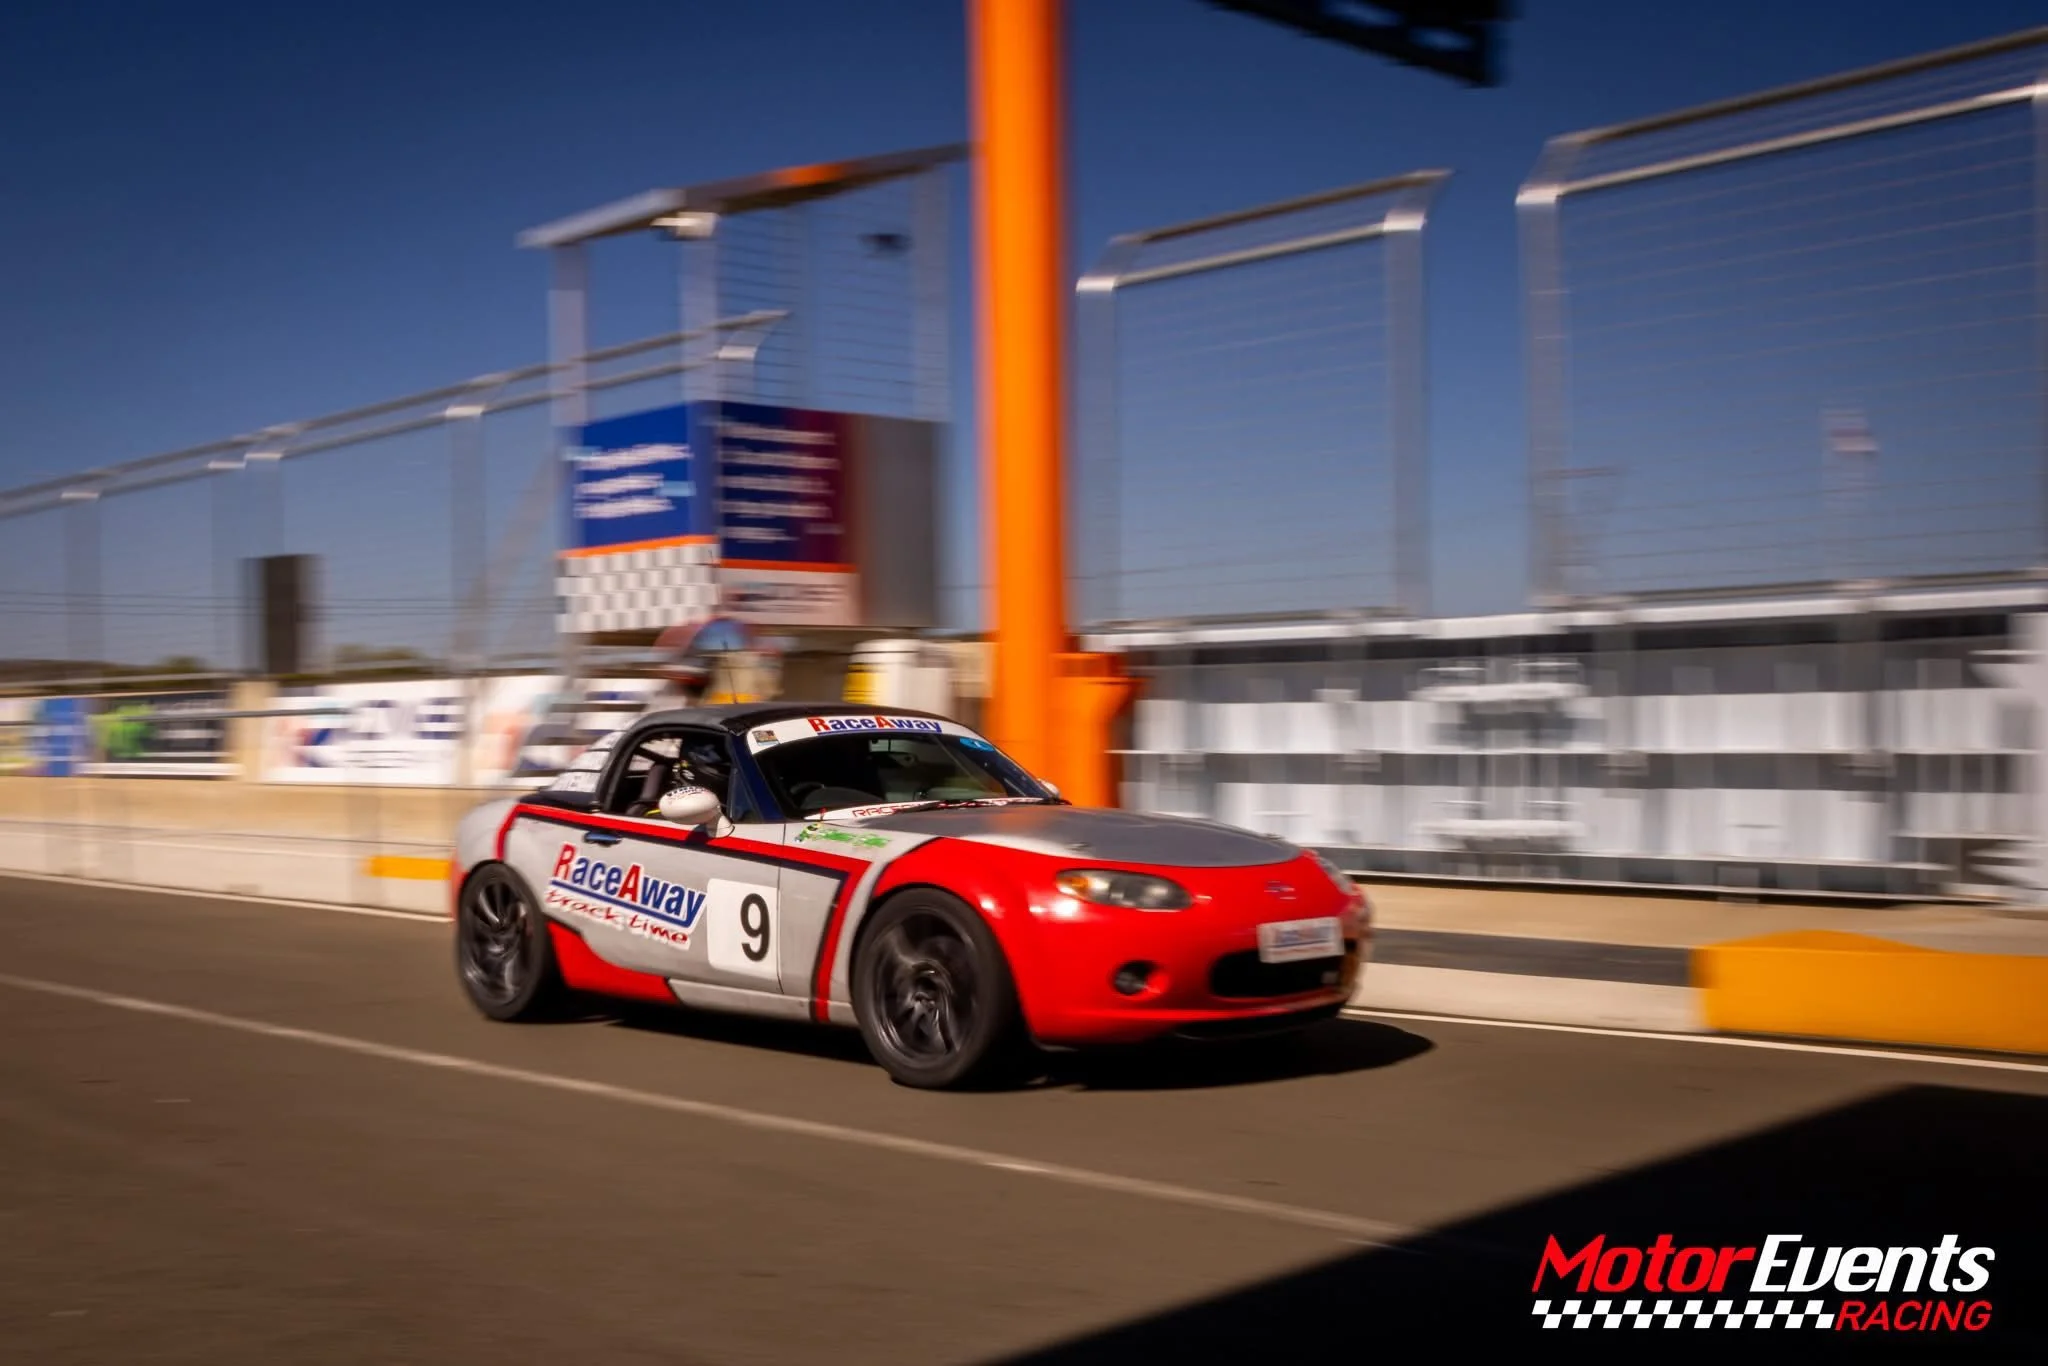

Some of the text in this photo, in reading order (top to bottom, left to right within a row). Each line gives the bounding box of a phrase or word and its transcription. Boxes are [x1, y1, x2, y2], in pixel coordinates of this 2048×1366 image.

[808, 715, 943, 734] RaceAway
[553, 844, 707, 919] RaceAway
[545, 888, 690, 944] track time
[740, 893, 770, 962] 9
